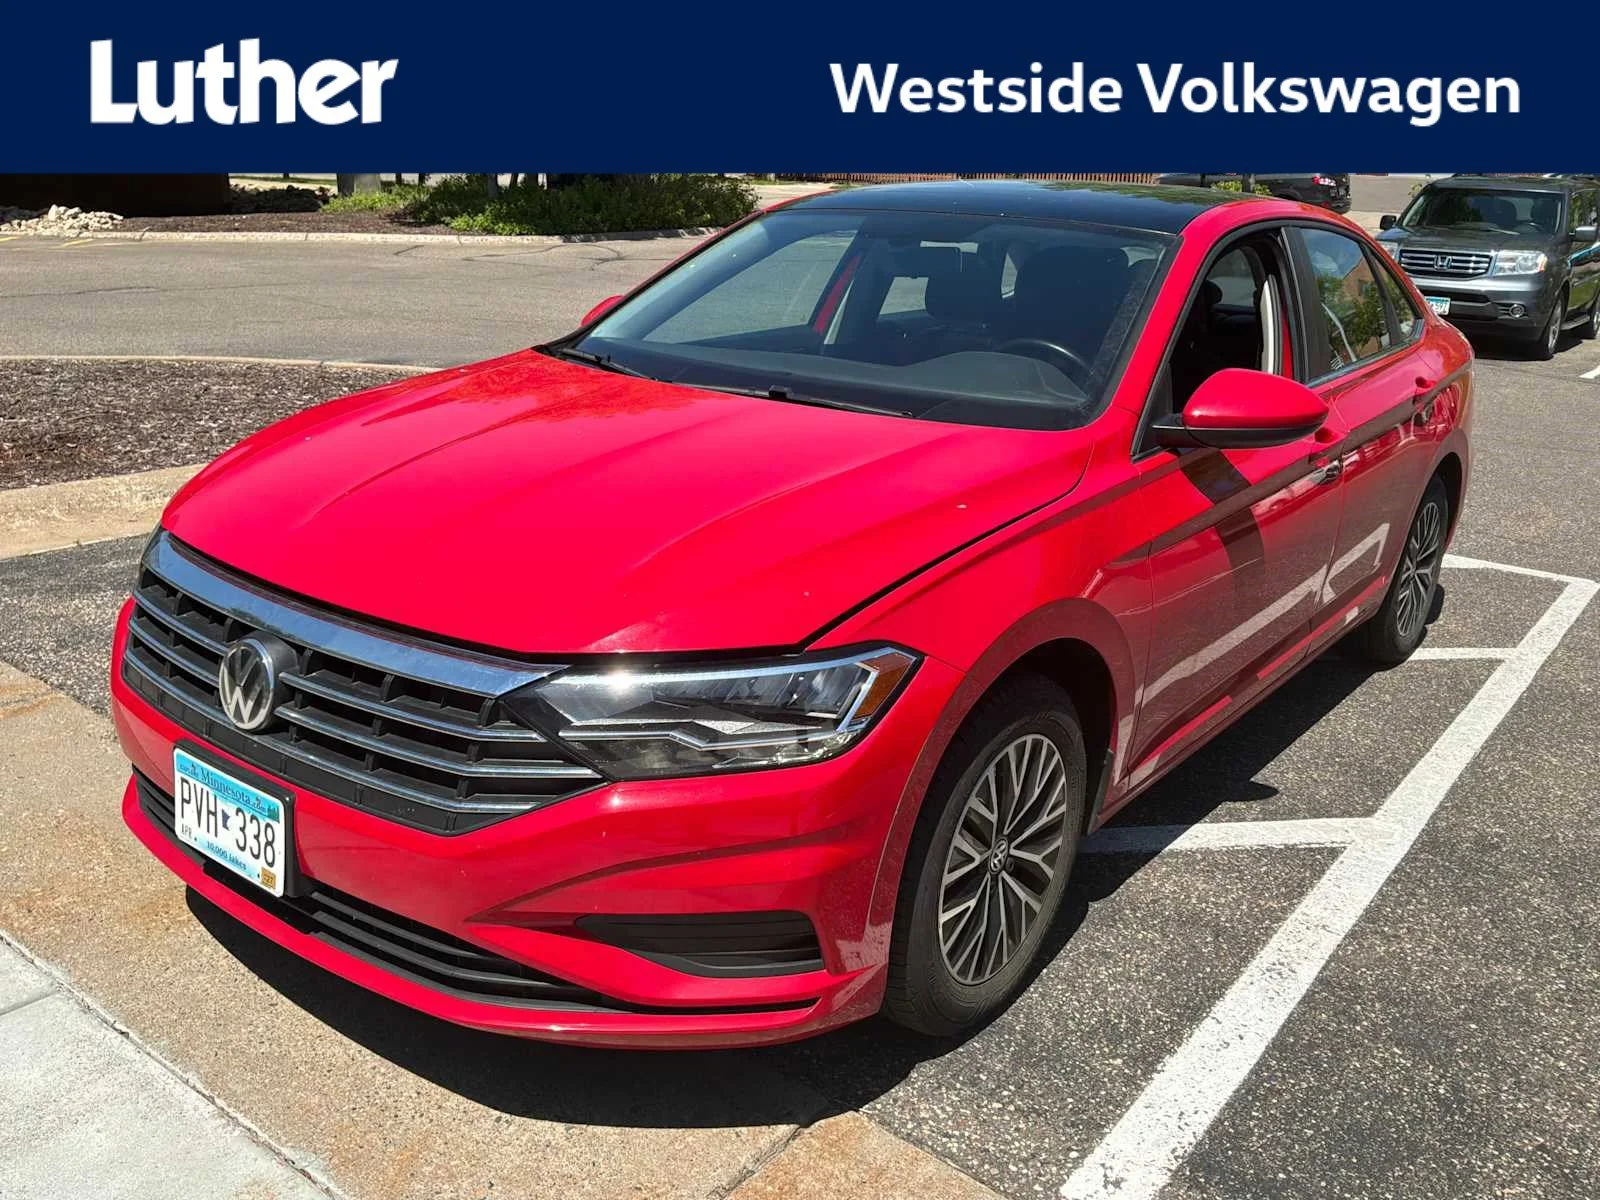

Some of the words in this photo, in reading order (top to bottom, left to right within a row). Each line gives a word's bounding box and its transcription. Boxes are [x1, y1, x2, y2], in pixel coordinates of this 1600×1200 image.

[201, 766, 250, 805] Minnesota
[180, 777, 217, 838] PVH
[235, 807, 275, 868] 338
[207, 841, 228, 859] 10,000
[229, 849, 247, 870] lakes
